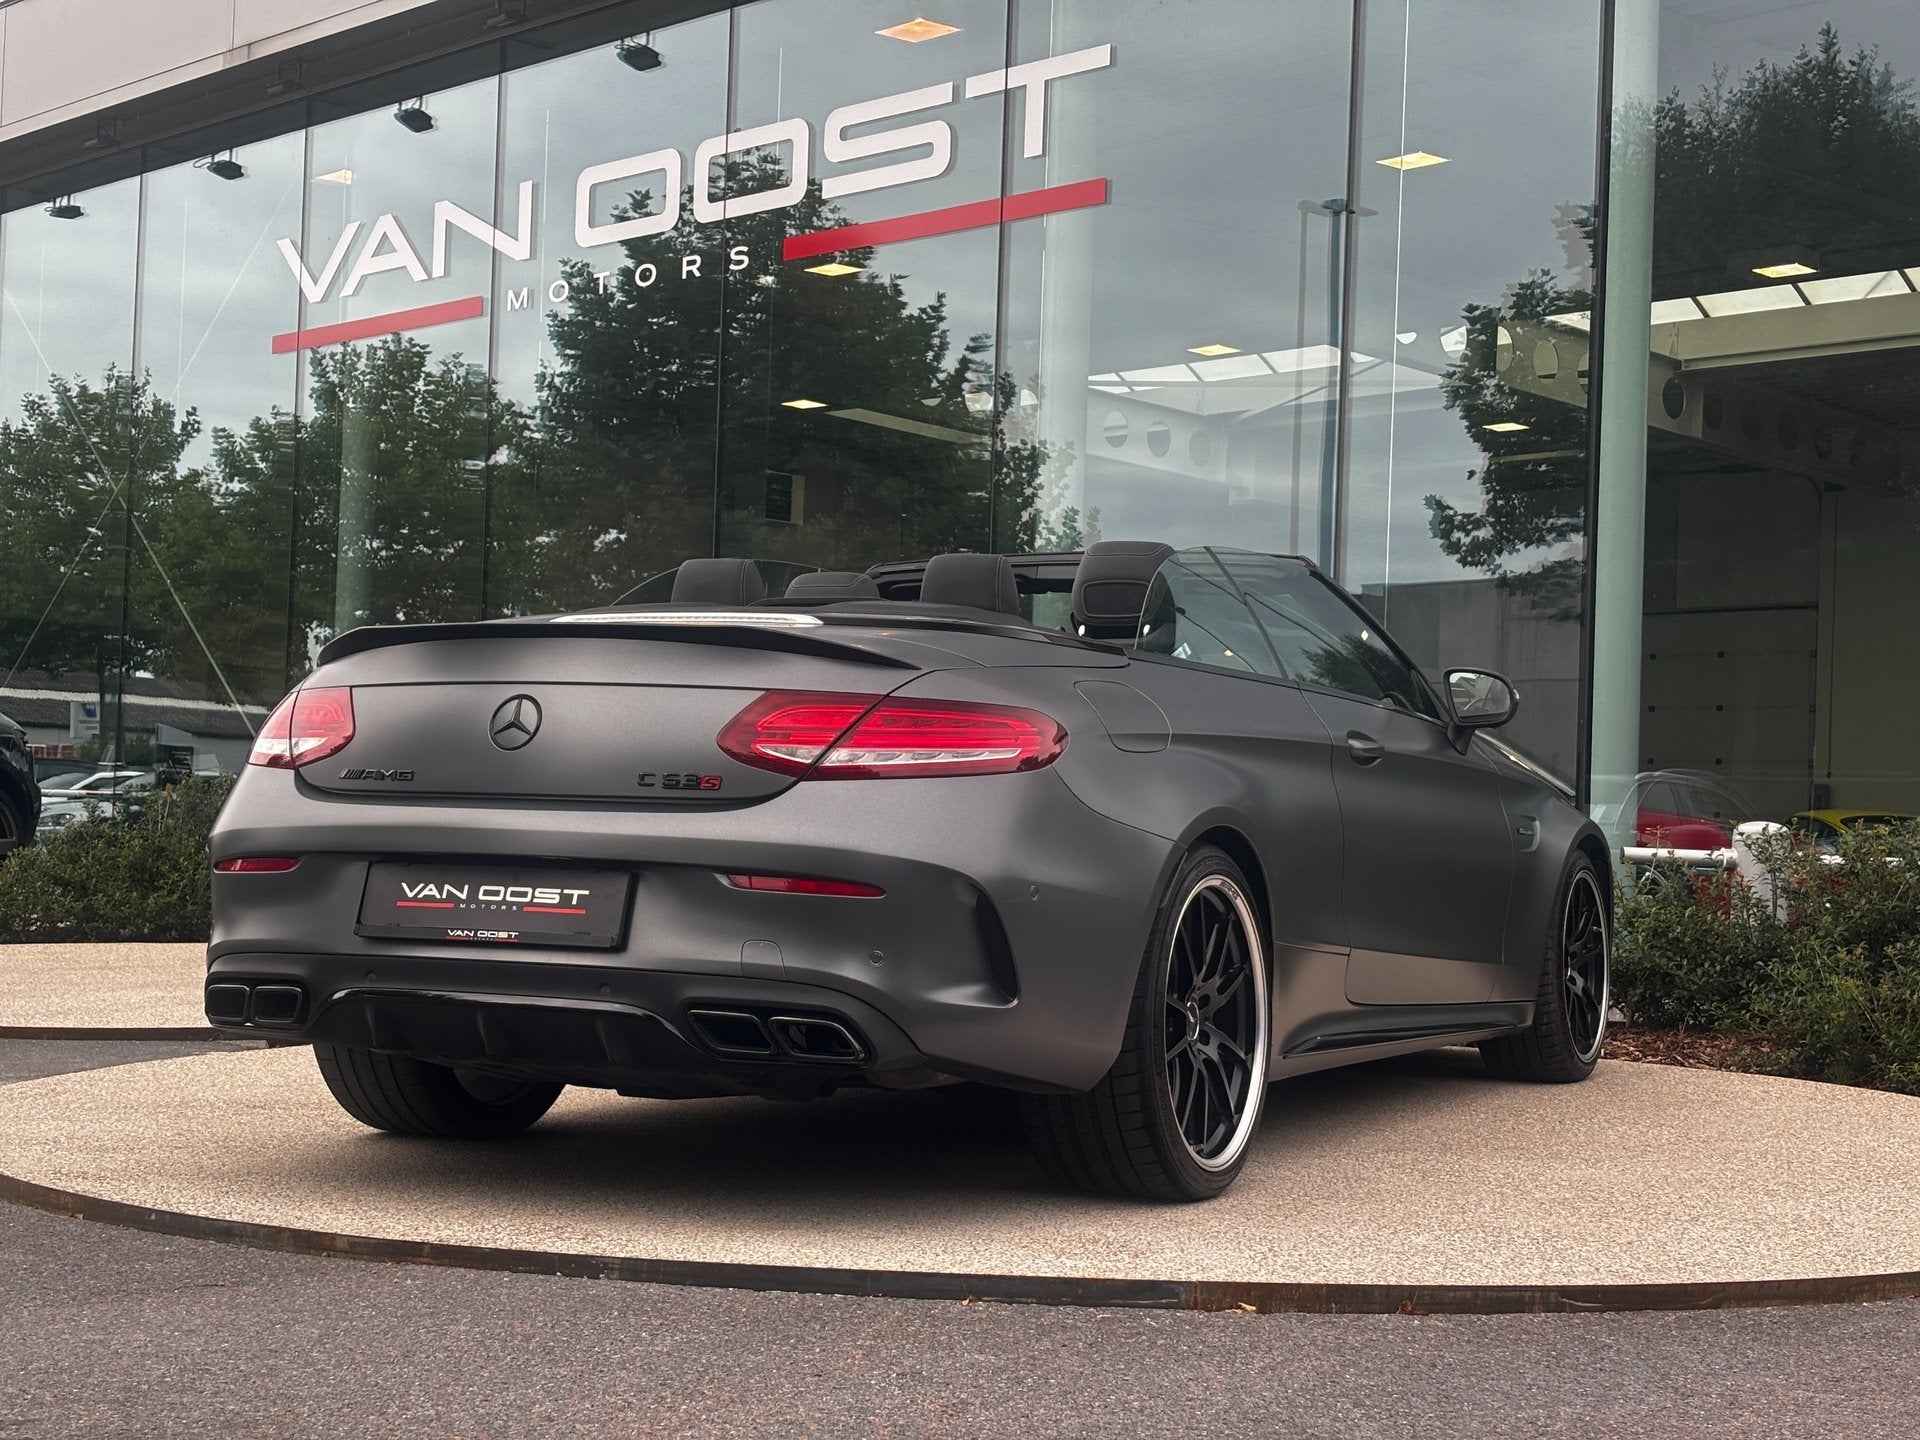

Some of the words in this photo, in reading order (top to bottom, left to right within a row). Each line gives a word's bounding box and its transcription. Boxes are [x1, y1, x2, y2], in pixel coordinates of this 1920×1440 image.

[276, 180, 533, 303] VAN
[575, 43, 1112, 248] OOST
[507, 246, 750, 311] MOTORS
[360, 769, 415, 781] AMG
[637, 772, 656, 787] C
[401, 882, 469, 899] VAN
[478, 886, 589, 905] OOST
[460, 903, 517, 911] MOTORS
[477, 930, 519, 938] OOST
